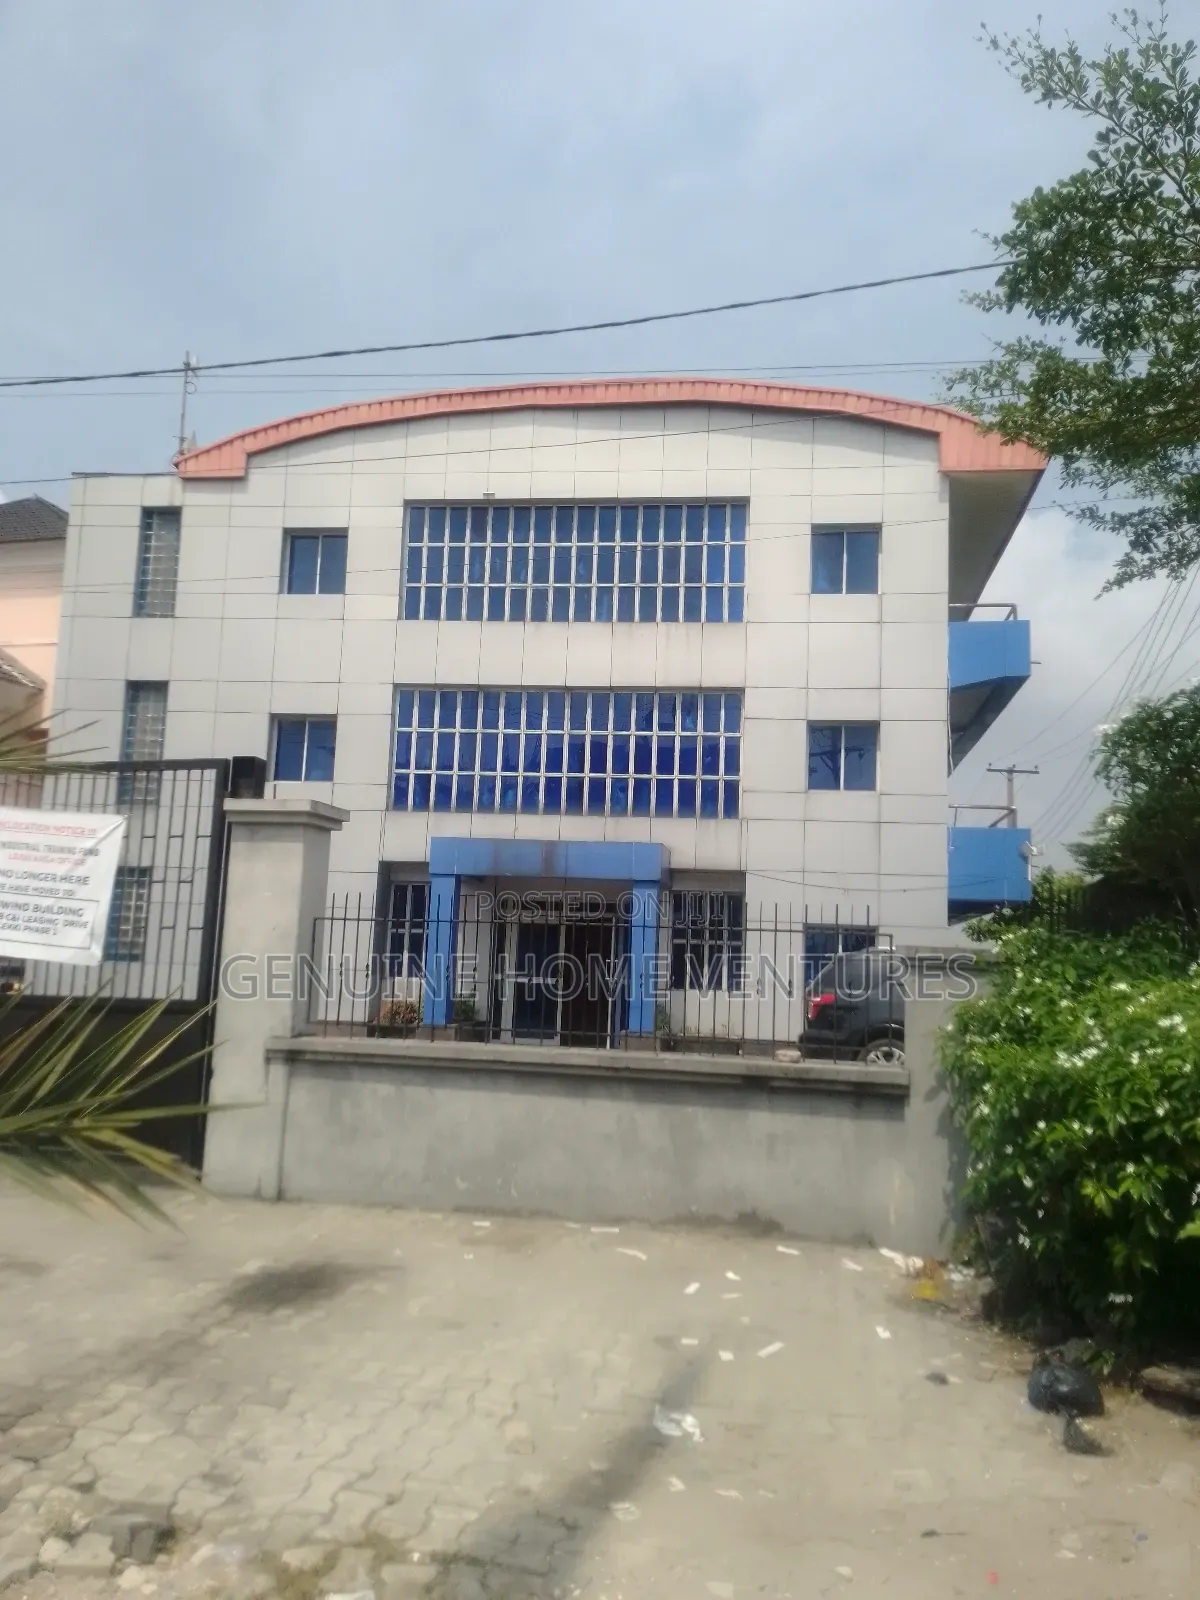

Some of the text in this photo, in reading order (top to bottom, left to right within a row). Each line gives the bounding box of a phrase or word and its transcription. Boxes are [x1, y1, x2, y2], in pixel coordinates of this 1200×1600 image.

[0, 840, 40, 852] NDUSTRIAL
[15, 870, 57, 883] LONGER
[59, 874, 91, 886] HERE
[8, 884, 31, 893] HAVE
[32, 886, 60, 896] MOVED
[0, 899, 85, 918] WING BUILDING
[0, 922, 21, 931] EKKI
[23, 925, 51, 935] PHASE
[22, 915, 59, 926] LEASING
[62, 919, 89, 929] DRIVE
